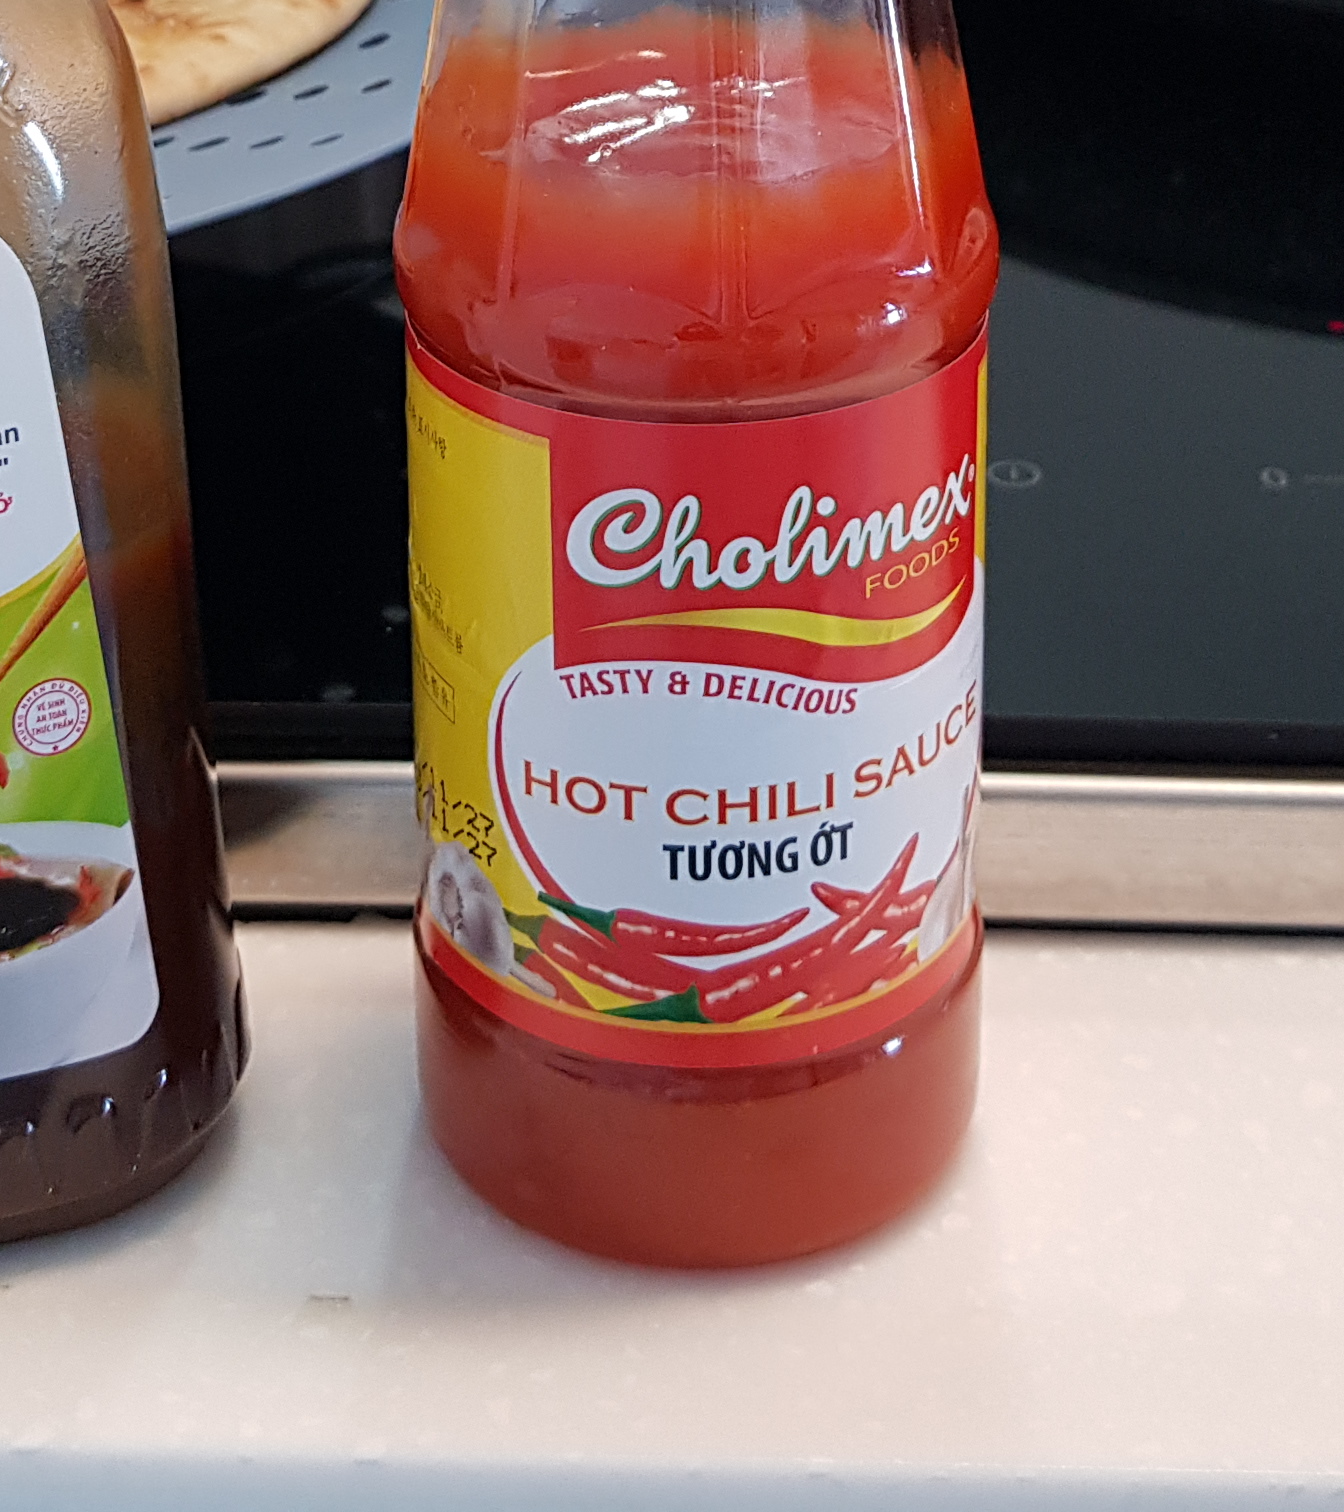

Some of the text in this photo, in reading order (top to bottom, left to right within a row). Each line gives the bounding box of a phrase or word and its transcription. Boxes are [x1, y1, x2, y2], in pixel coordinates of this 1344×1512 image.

[566, 453, 971, 590] Cholimex
[864, 526, 962, 600] FOODS
[559, 668, 859, 716] TASTY & DELICIOUS
[522, 677, 978, 827] HOT CHILI SAUCE
[662, 822, 854, 881] TƯƠNG ỚT
